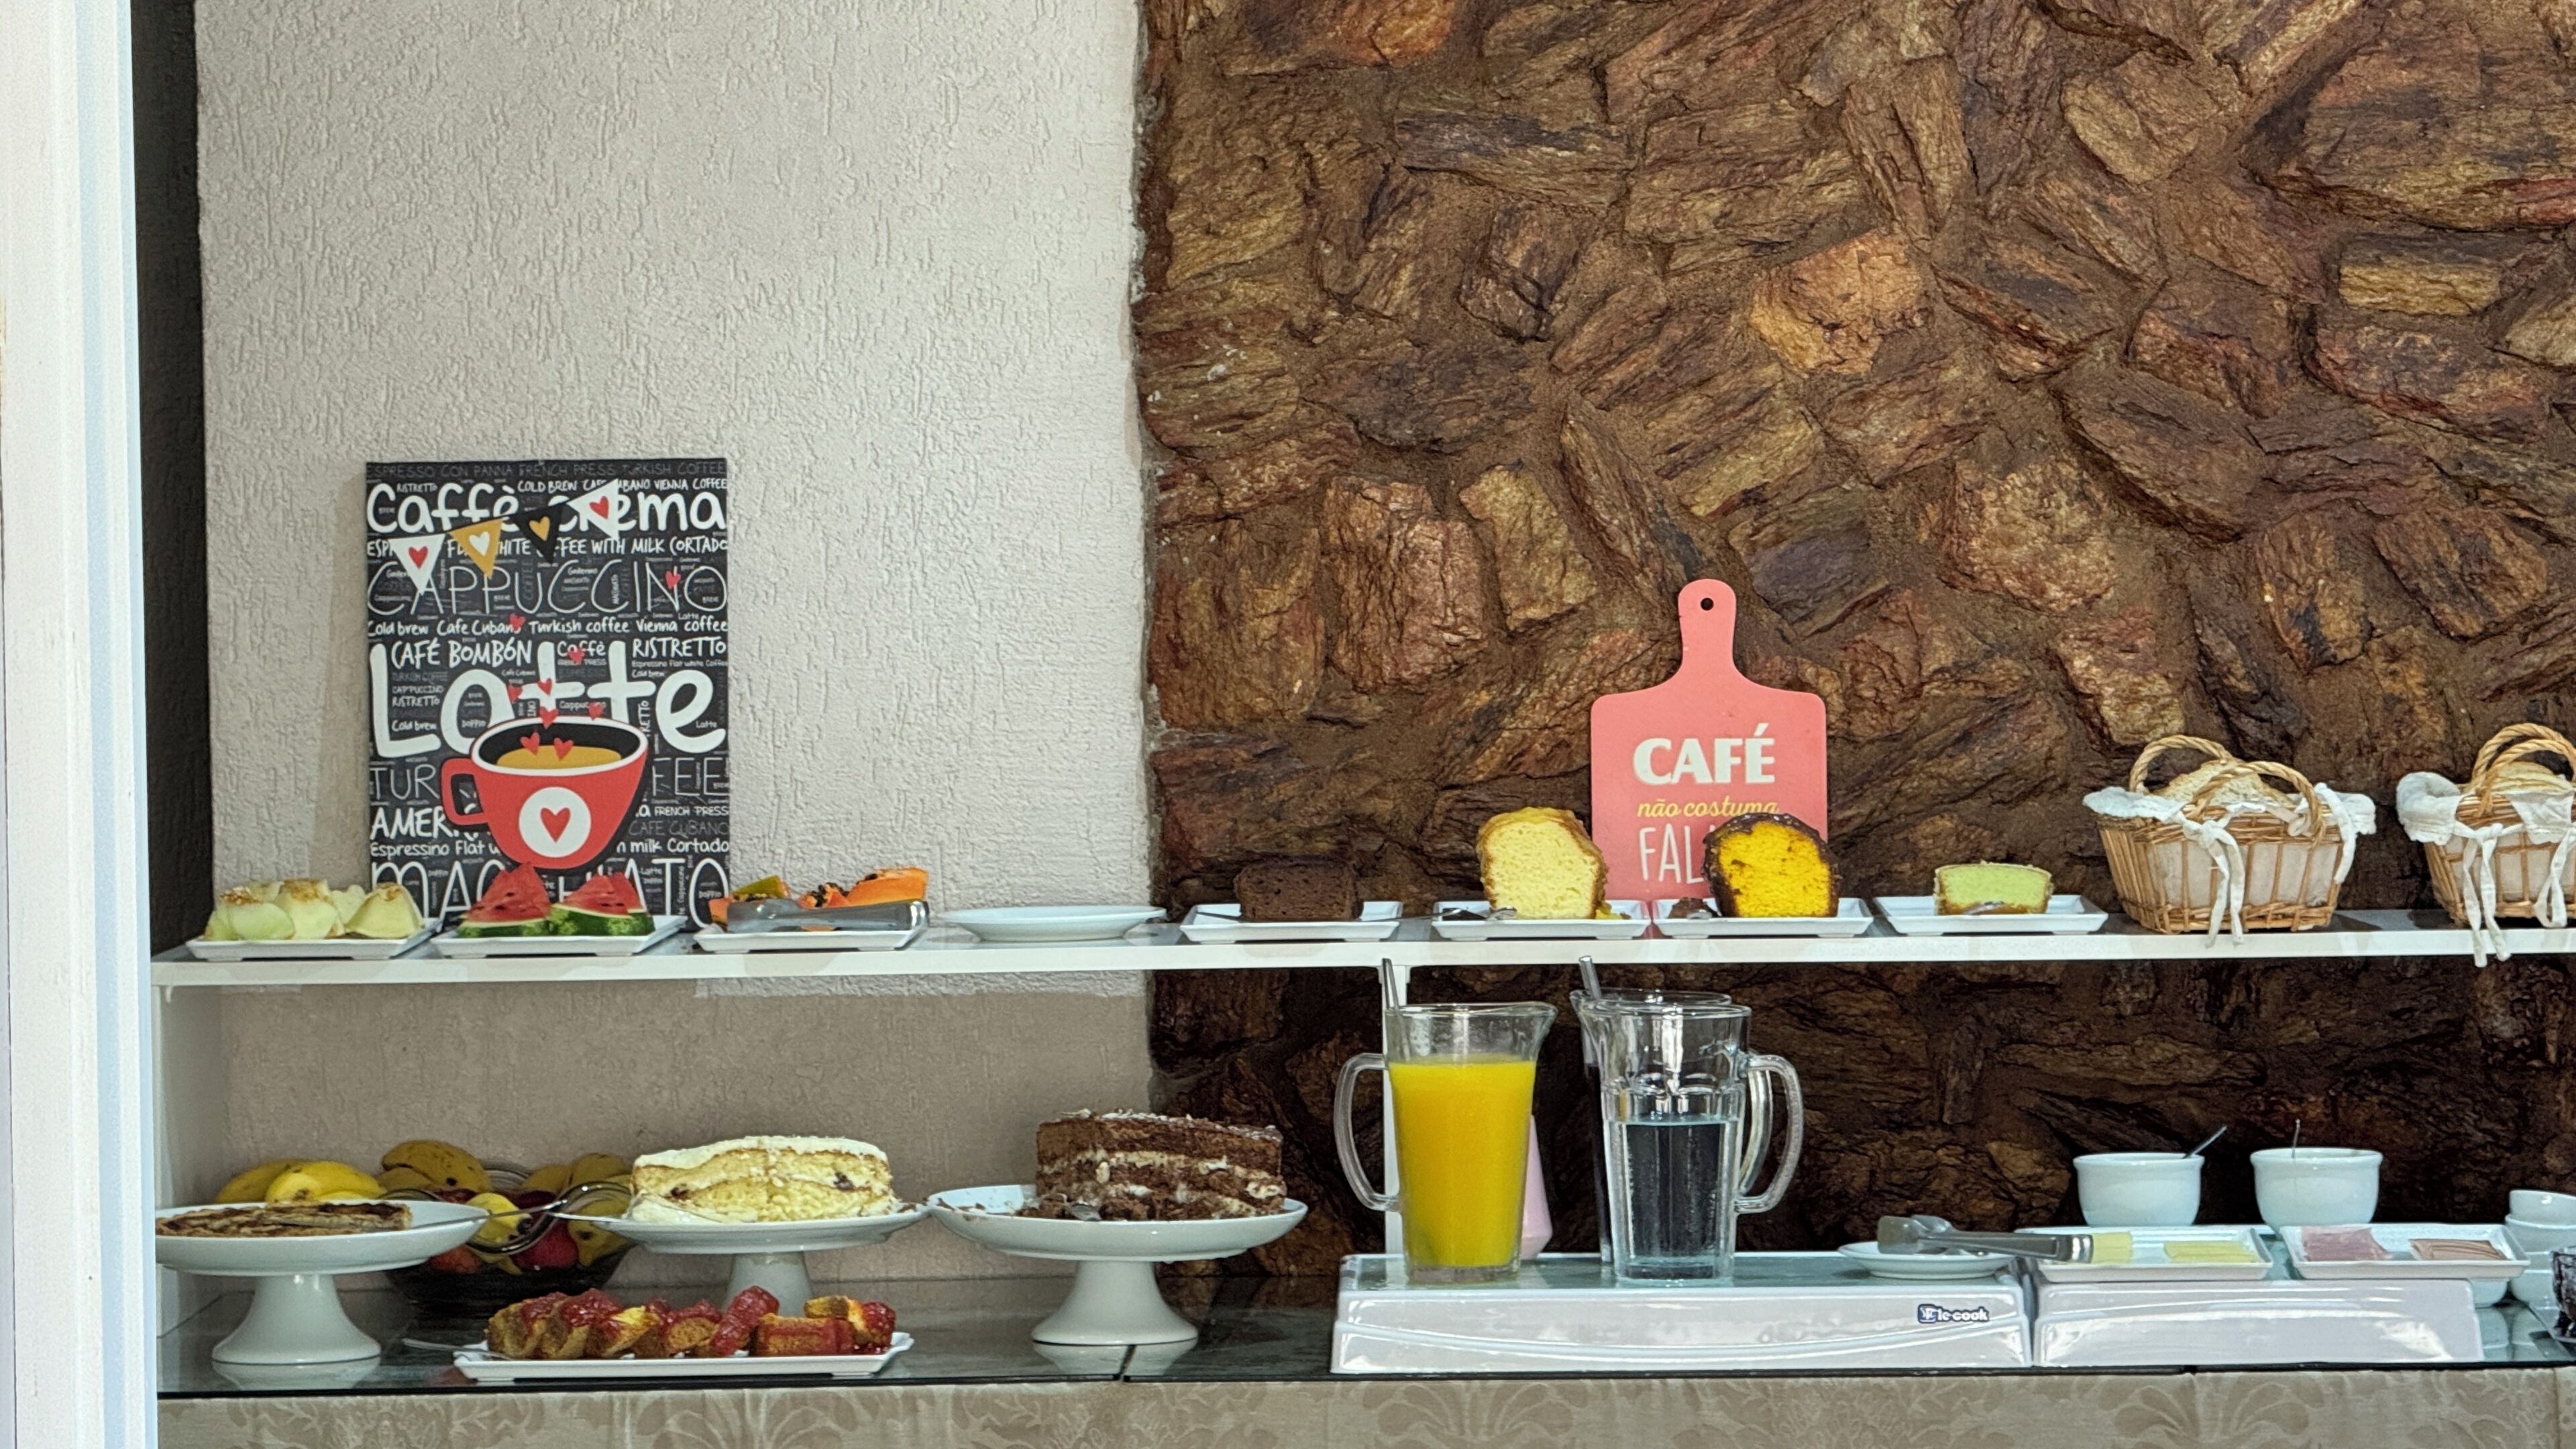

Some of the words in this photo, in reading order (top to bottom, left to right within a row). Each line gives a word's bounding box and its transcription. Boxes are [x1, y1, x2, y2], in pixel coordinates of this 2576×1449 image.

[367, 464, 435, 479] ESPRESSO
[439, 464, 469, 478] CON
[474, 464, 513, 478] PANNA
[519, 463, 568, 478] FRENCH
[574, 463, 617, 476] PRESS
[676, 461, 726, 476] COFFEE
[517, 480, 546, 493] COLD
[548, 480, 578, 494] BREW
[655, 479, 689, 491] VIENNA
[692, 478, 727, 490] COFFEE
[367, 482, 520, 533] Caffè
[591, 537, 625, 554] WITH
[631, 538, 665, 555] MILK
[367, 559, 727, 616] CAPPUCCINO
[368, 620, 394, 637] Cold
[397, 621, 429, 635] brew
[437, 619, 470, 637] Cafe
[529, 617, 582, 634] Turkish
[586, 616, 630, 633] coffee
[637, 618, 678, 633] Vienna
[684, 614, 728, 633] coffee
[391, 637, 441, 669] CAFÉ
[448, 637, 533, 669] BOMBÓN
[632, 637, 727, 659] RISTRETTO
[370, 639, 727, 759] Latte
[1633, 722, 1775, 785] CAFÉ
[1637, 798, 1680, 817] não
[1684, 796, 1780, 817] costuma
[370, 841, 450, 861] Espressino
[455, 840, 486, 856] Flat
[630, 839, 663, 853] milk
[667, 837, 729, 853] Cortado
